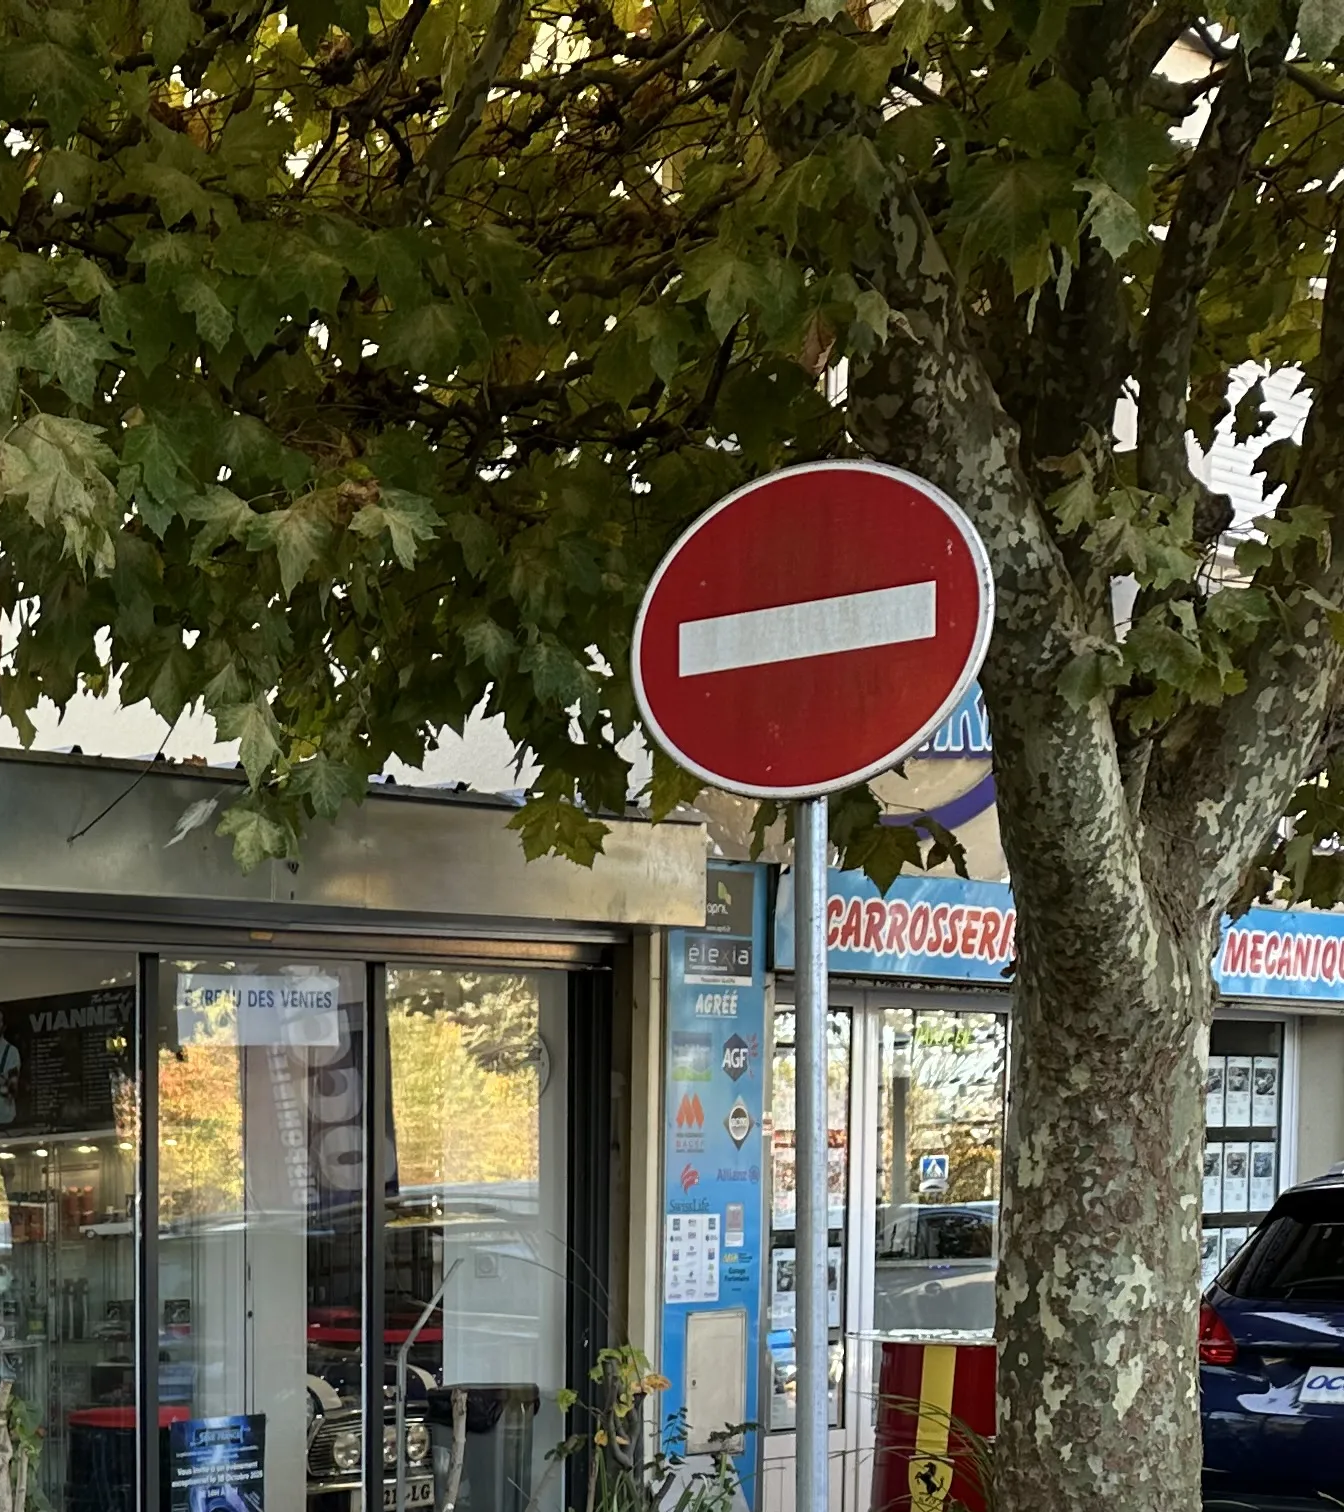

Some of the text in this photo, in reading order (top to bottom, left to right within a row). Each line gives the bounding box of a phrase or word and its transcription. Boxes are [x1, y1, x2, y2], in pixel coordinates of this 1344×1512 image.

[826, 896, 1016, 963] CARROSSERI
[184, 988, 333, 1009] BREU DES VENTES
[695, 988, 739, 1016] AGRÉÉ
[28, 1001, 134, 1033] VIANNEY
[721, 1048, 749, 1068] AGF
